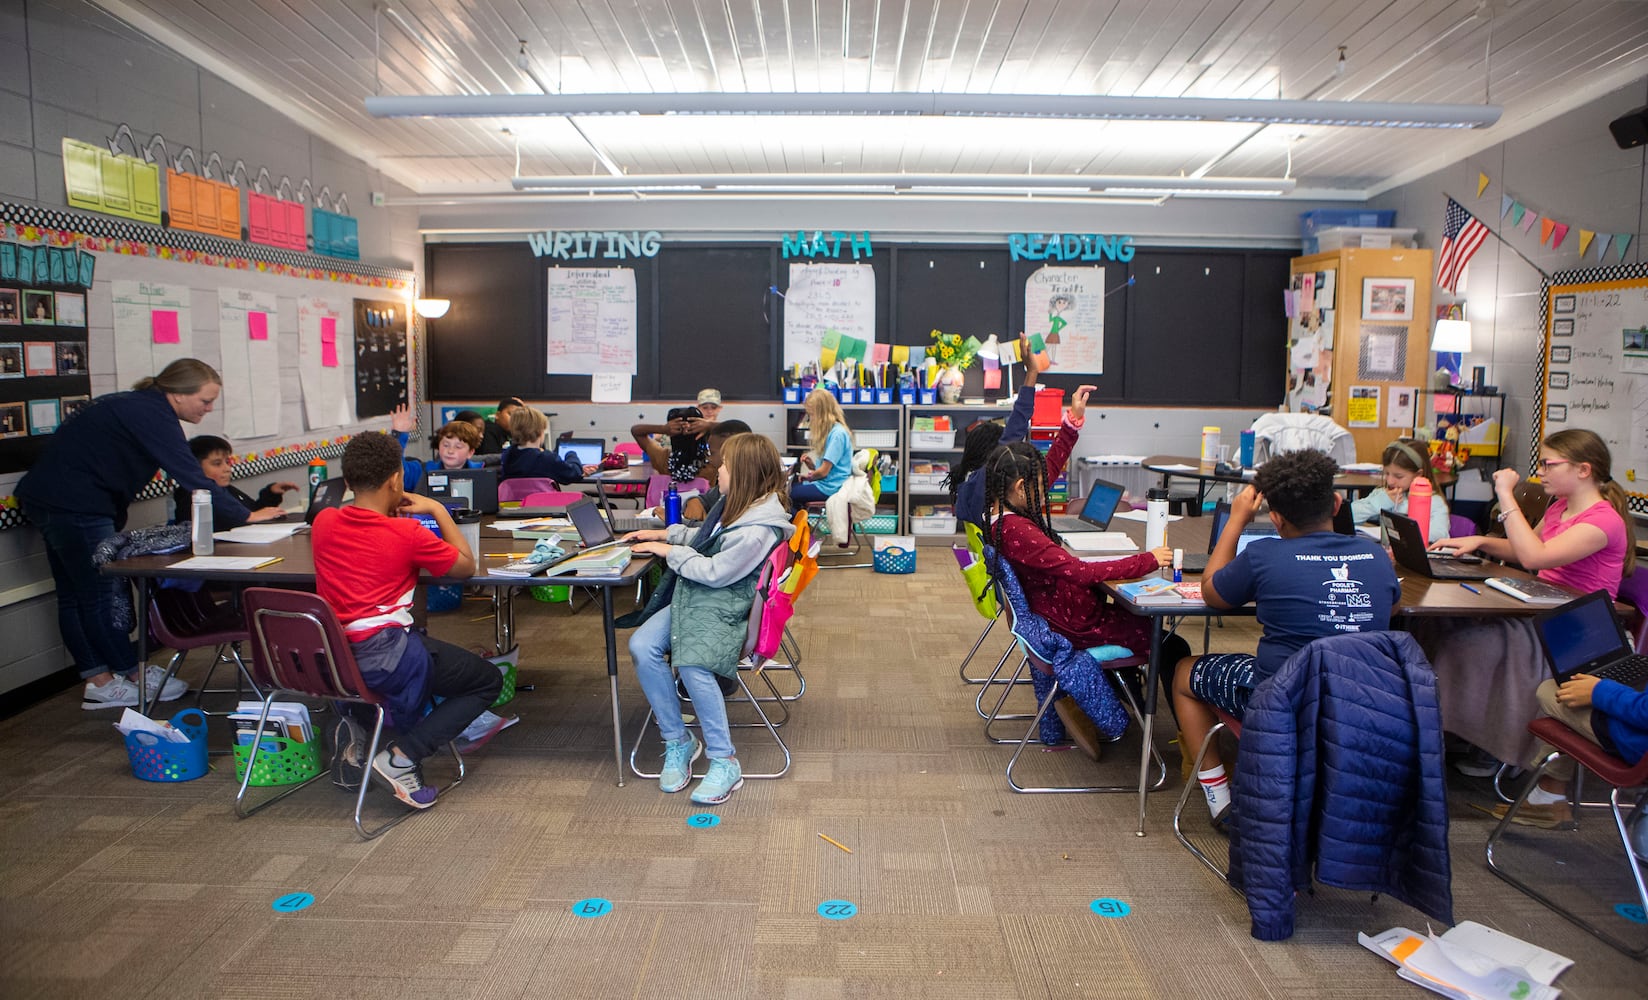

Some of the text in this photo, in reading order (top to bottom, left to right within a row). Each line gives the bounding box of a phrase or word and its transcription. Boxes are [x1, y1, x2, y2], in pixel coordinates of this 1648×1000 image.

[527, 231, 662, 259] WRITING
[782, 230, 873, 259] MATH
[1008, 233, 1135, 262] READING
[696, 816, 713, 825] 16
[279, 896, 307, 908] 17
[582, 902, 604, 914] 19
[1098, 902, 1124, 914] 15
[824, 904, 852, 915] 22
